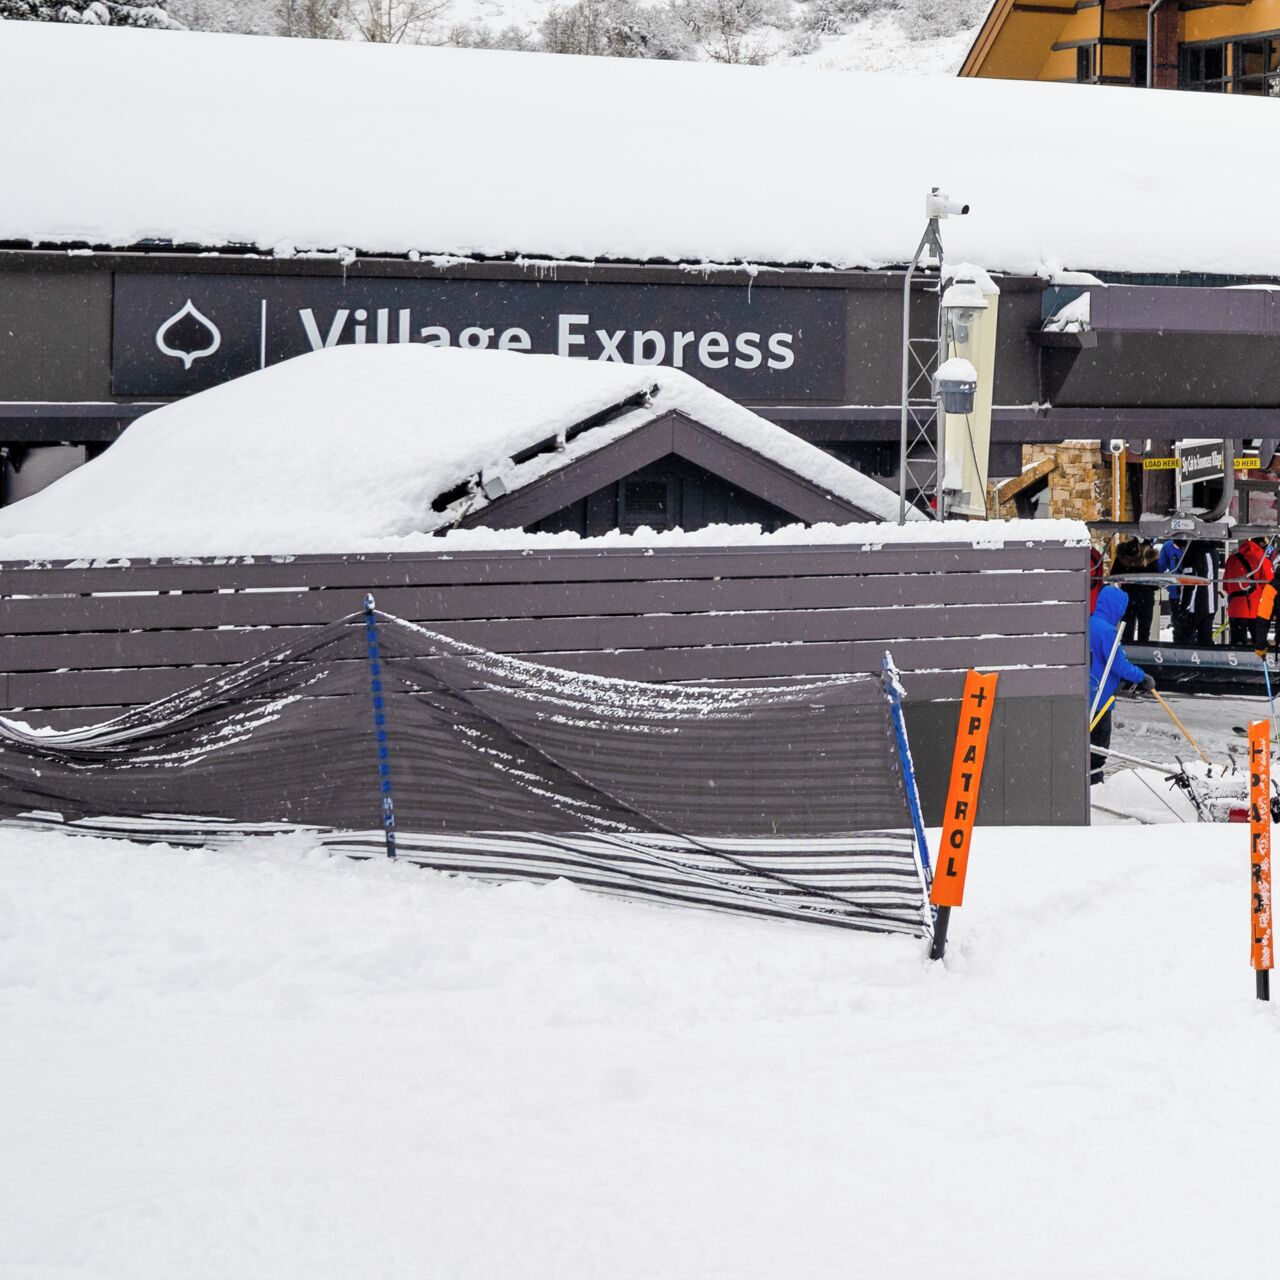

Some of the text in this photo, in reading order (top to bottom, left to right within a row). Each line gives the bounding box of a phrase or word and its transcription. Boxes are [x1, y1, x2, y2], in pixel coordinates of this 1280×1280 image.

[558, 314, 796, 370] Express
[1144, 458, 1180, 468] LOAD HERE
[1241, 458, 1258, 467] HERE
[1173, 520, 1181, 528] 24
[1153, 650, 1164, 663] 3
[1191, 651, 1201, 665] 4
[1228, 653, 1238, 666] 5
[946, 716, 981, 877] PATROL
